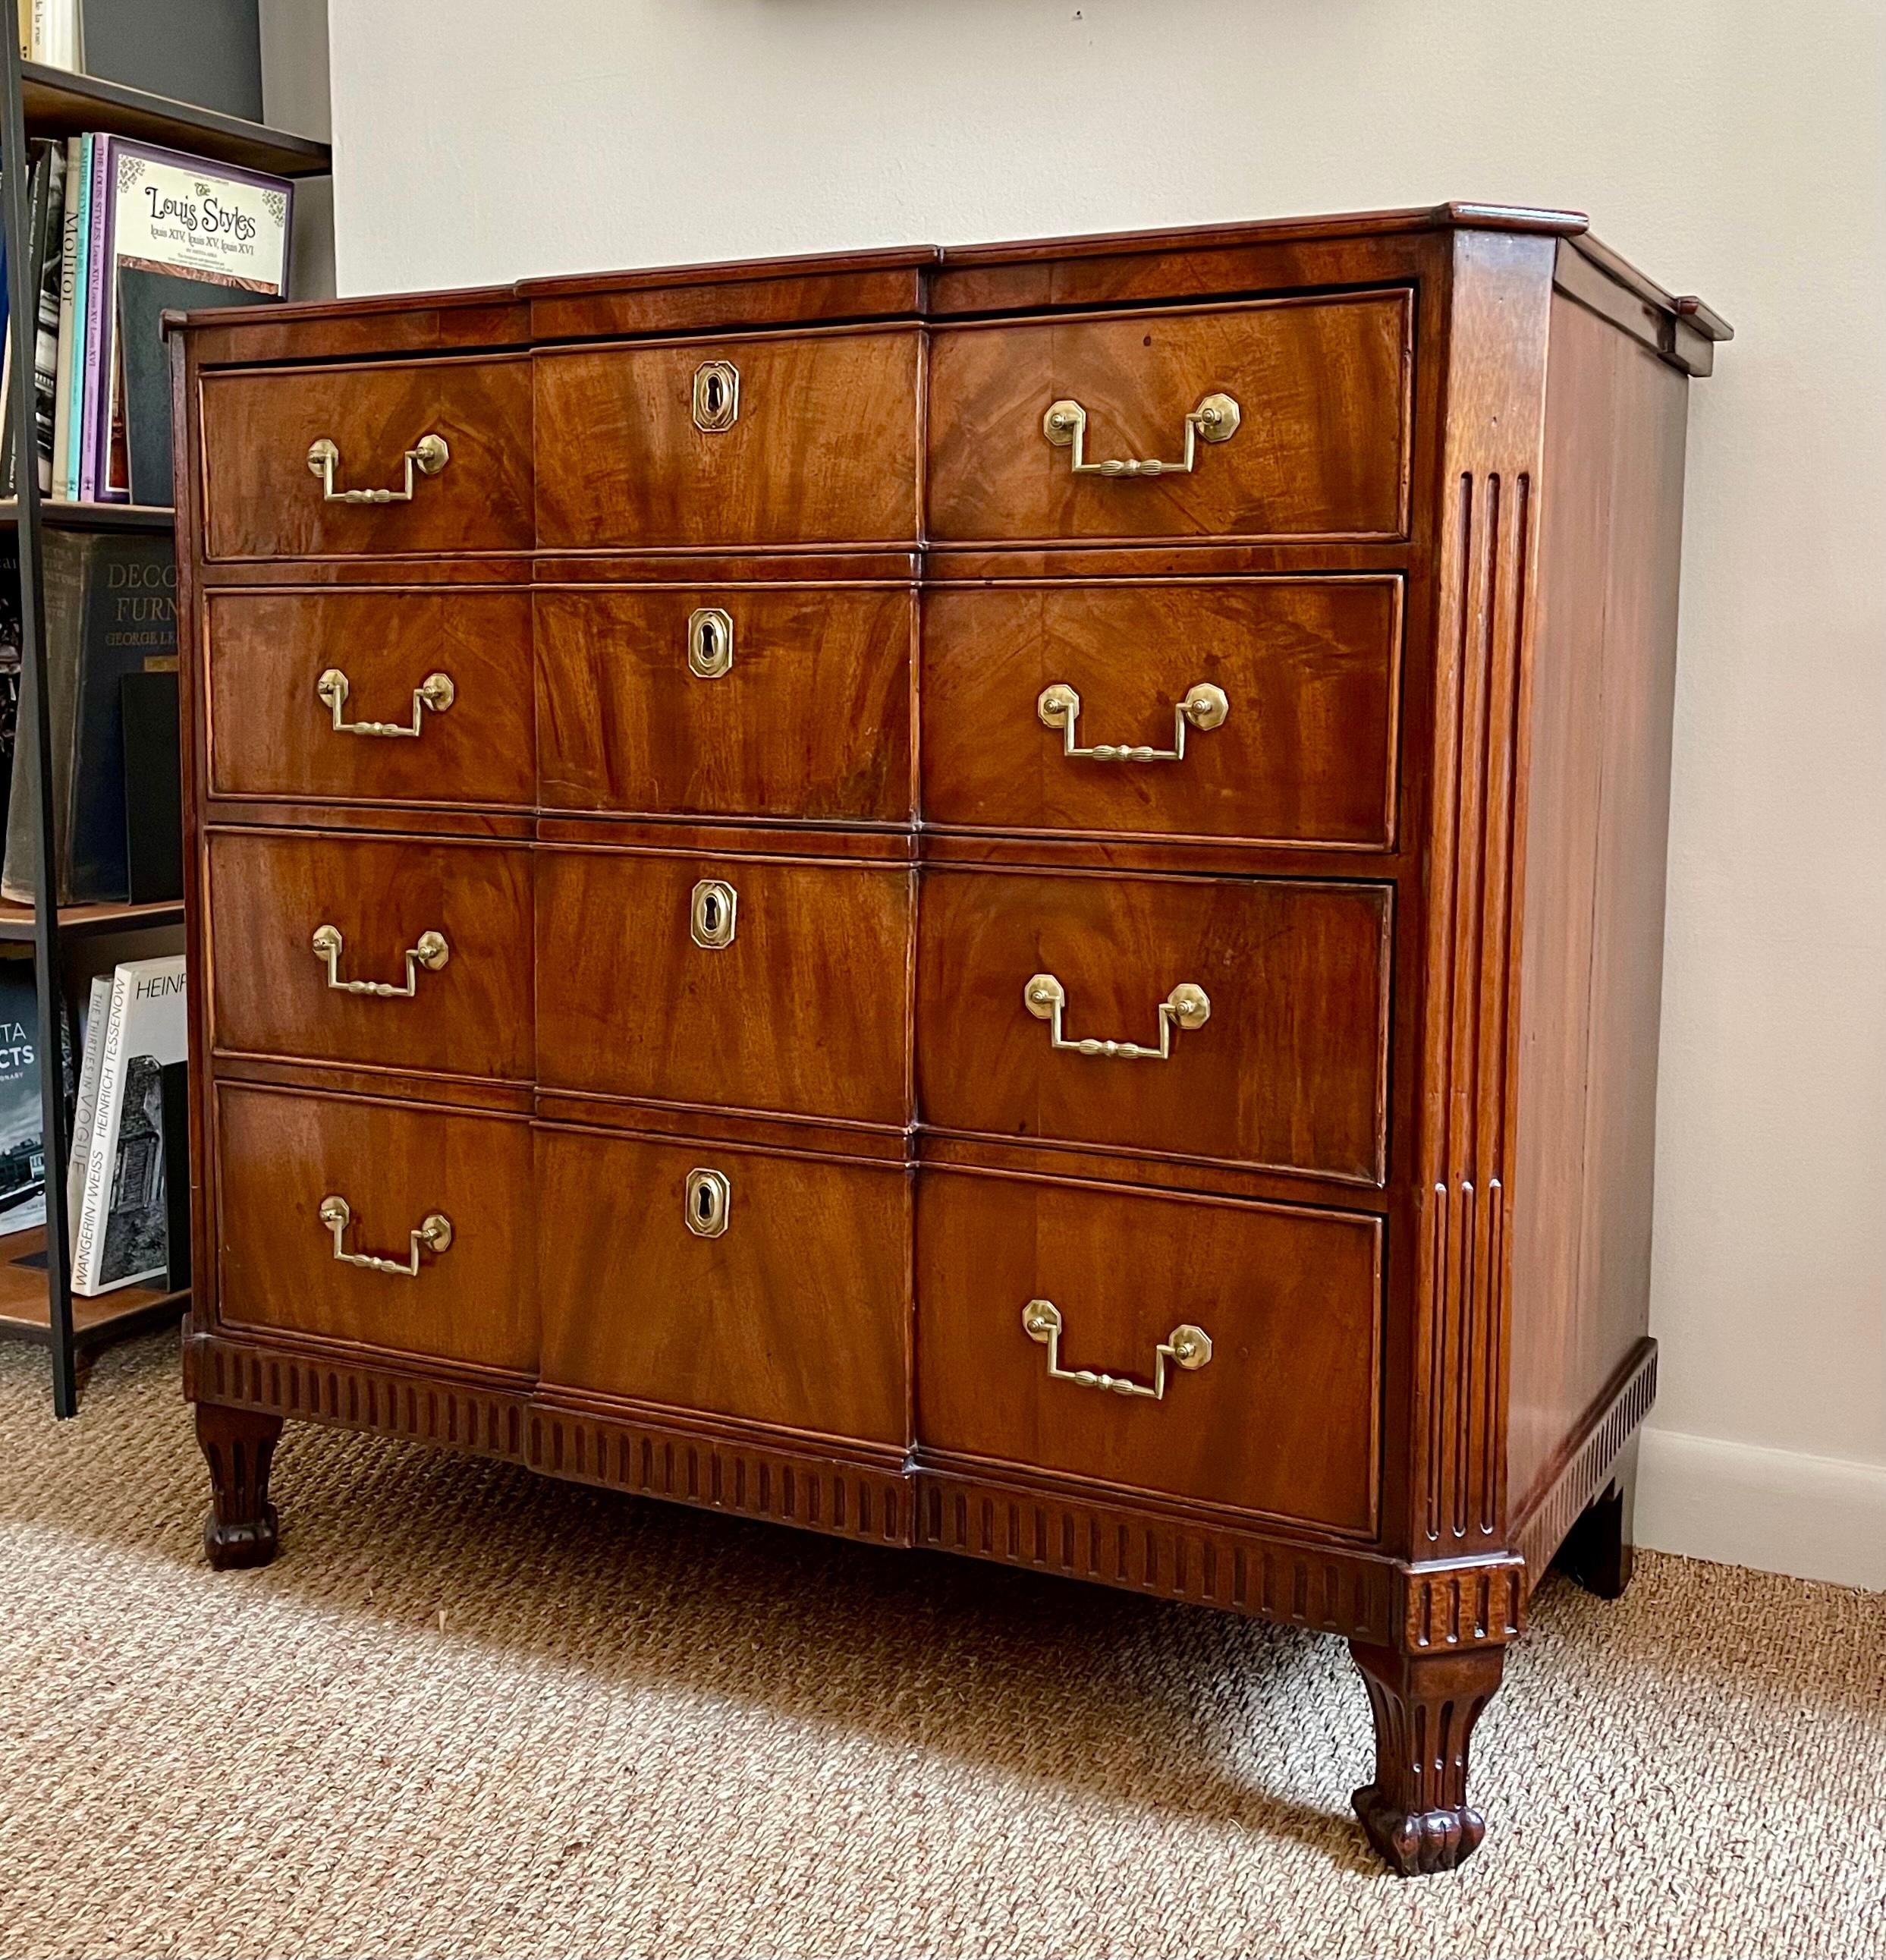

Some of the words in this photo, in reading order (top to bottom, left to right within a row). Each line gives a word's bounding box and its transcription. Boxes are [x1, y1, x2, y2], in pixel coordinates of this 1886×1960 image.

[35, 14, 42, 23] la
[96, 146, 104, 166] THE
[93, 201, 102, 241] STYLES
[145, 187, 197, 231] Louis
[202, 198, 256, 240] Styles
[62, 212, 78, 306] Molitor
[238, 244, 254, 256] XVI
[105, 631, 158, 646] GEORGE
[93, 993, 102, 1015] THE
[84, 1020, 99, 1072] THIRTIES
[96, 1068, 114, 1137] HEINRICH
[105, 977, 125, 1063] TESSENOW
[81, 1077, 93, 1089] IN
[73, 1093, 94, 1173] VOGUE
